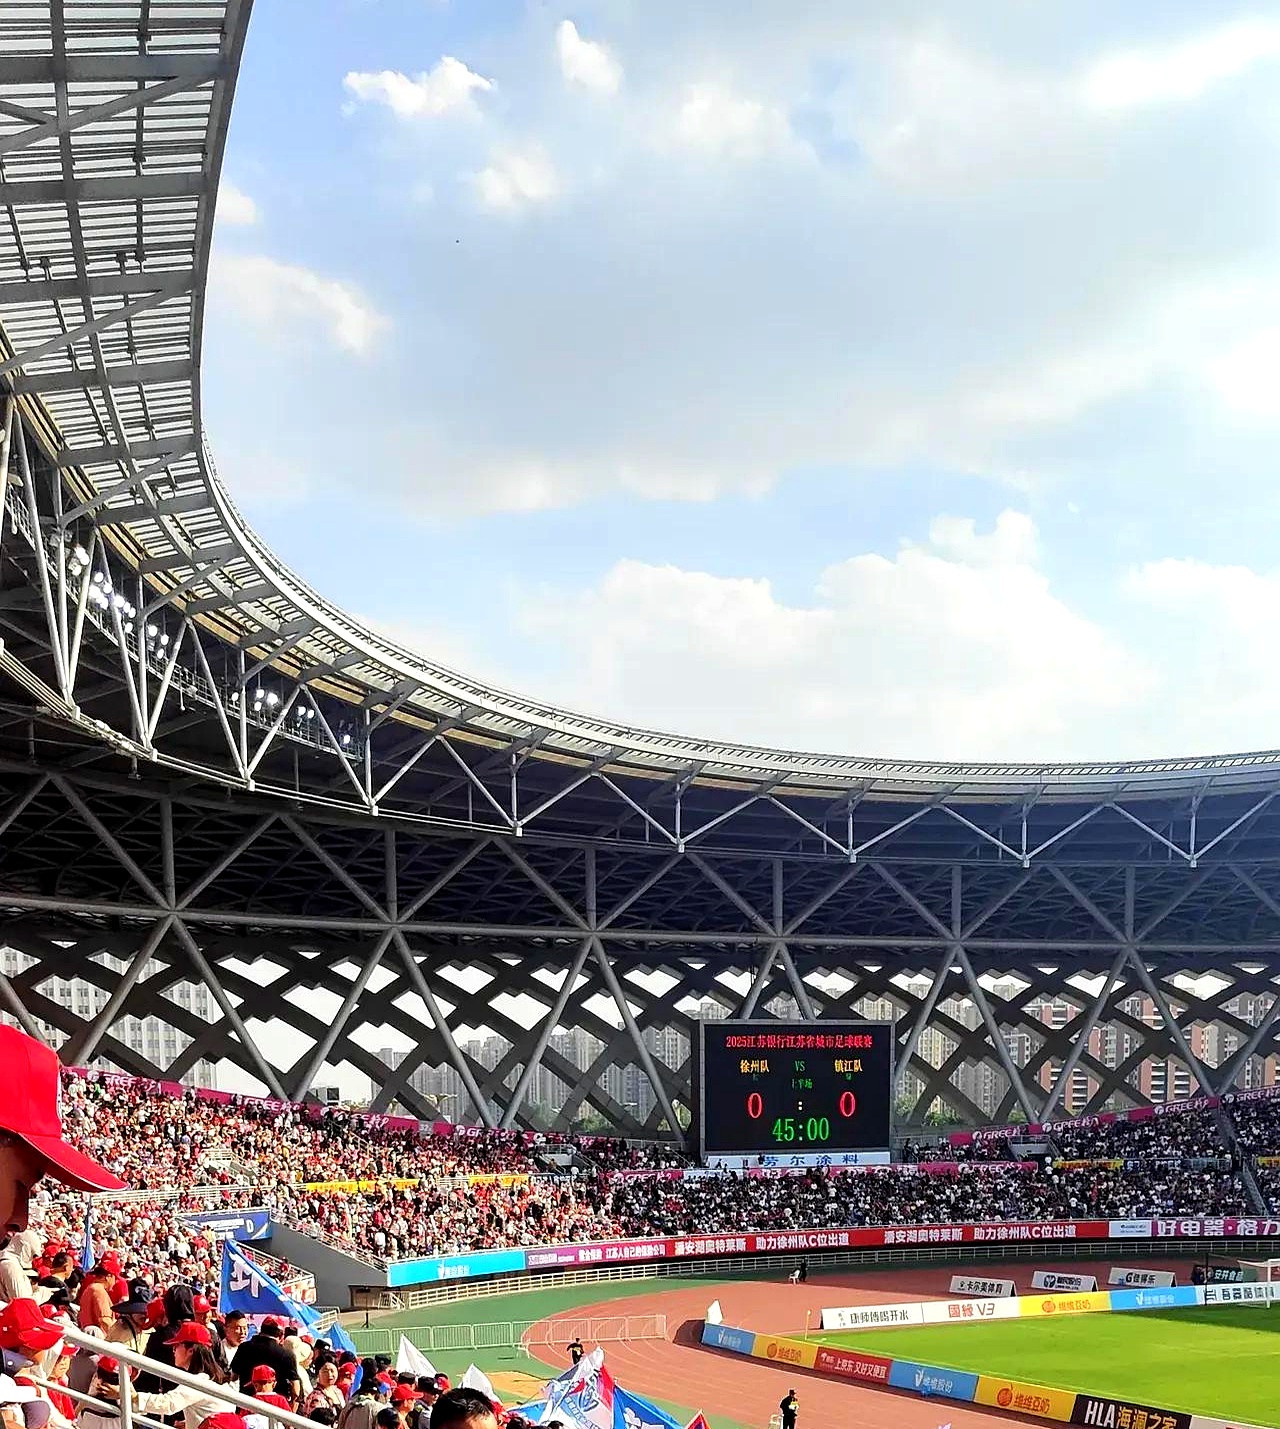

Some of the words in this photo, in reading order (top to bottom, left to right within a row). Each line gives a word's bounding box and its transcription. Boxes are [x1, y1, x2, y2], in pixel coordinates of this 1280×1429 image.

[726, 1035, 873, 1049] 2025江苏银行江苏省城市足球联赛
[740, 1059, 769, 1073] 徐州队
[794, 1061, 806, 1072] VS
[834, 1059, 863, 1073] 镇江队
[747, 1092, 763, 1119] 0
[839, 1091, 856, 1117] 0
[772, 1117, 830, 1142] 45:00
[675, 1237, 747, 1255] 潘安湖奥特莱斯
[756, 1232, 850, 1250] 助力徐州队C位出道
[884, 1228, 963, 1244] 潘安湖奥特莱斯
[973, 1224, 1077, 1241] 助力徐州队C位出道
[976, 1302, 996, 1316] V3
[1014, 1392, 1050, 1414] 维维豆奶
[1085, 1400, 1115, 1429] HLA
